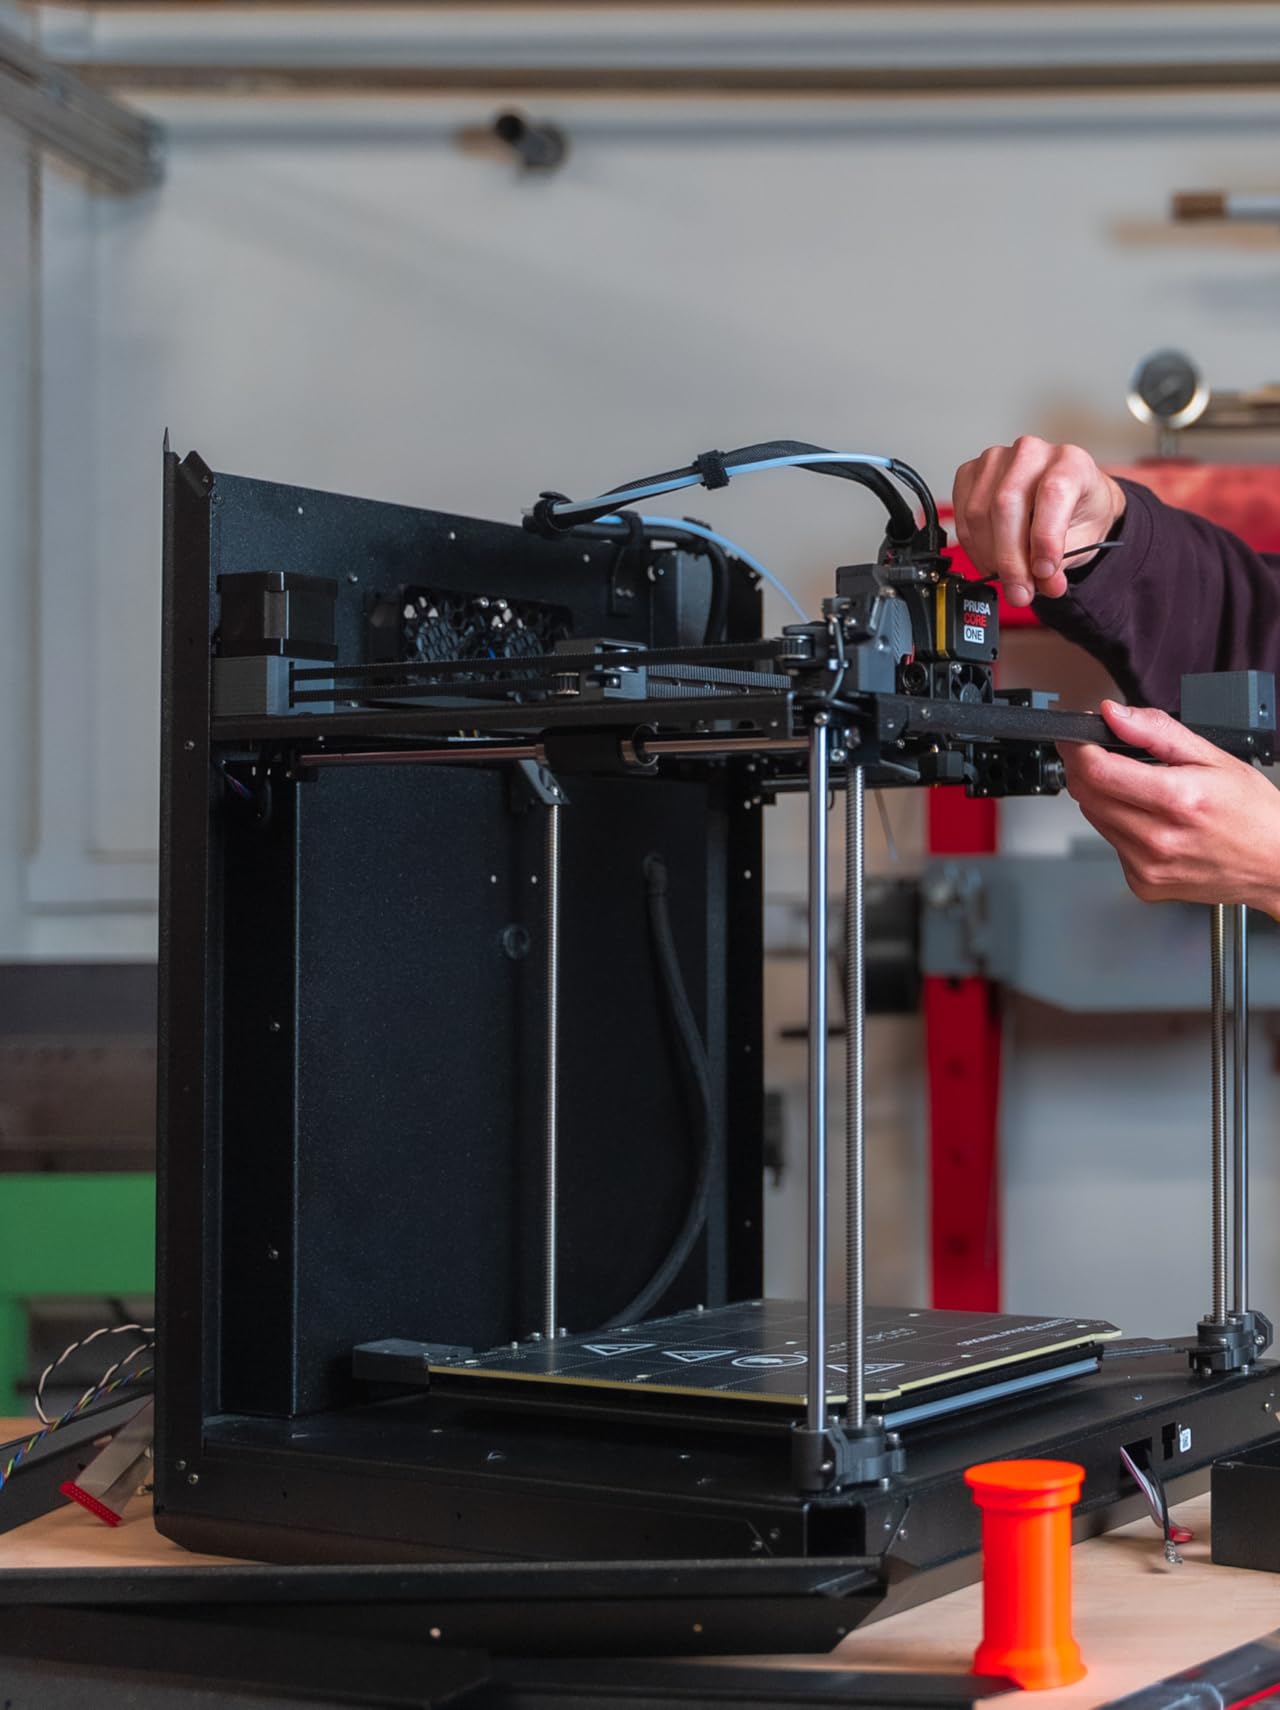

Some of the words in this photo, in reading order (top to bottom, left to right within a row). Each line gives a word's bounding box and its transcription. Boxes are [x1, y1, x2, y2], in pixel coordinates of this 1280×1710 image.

[964, 599, 991, 616] PRUSA
[964, 612, 988, 628] CORE
[966, 627, 983, 641] ONE
